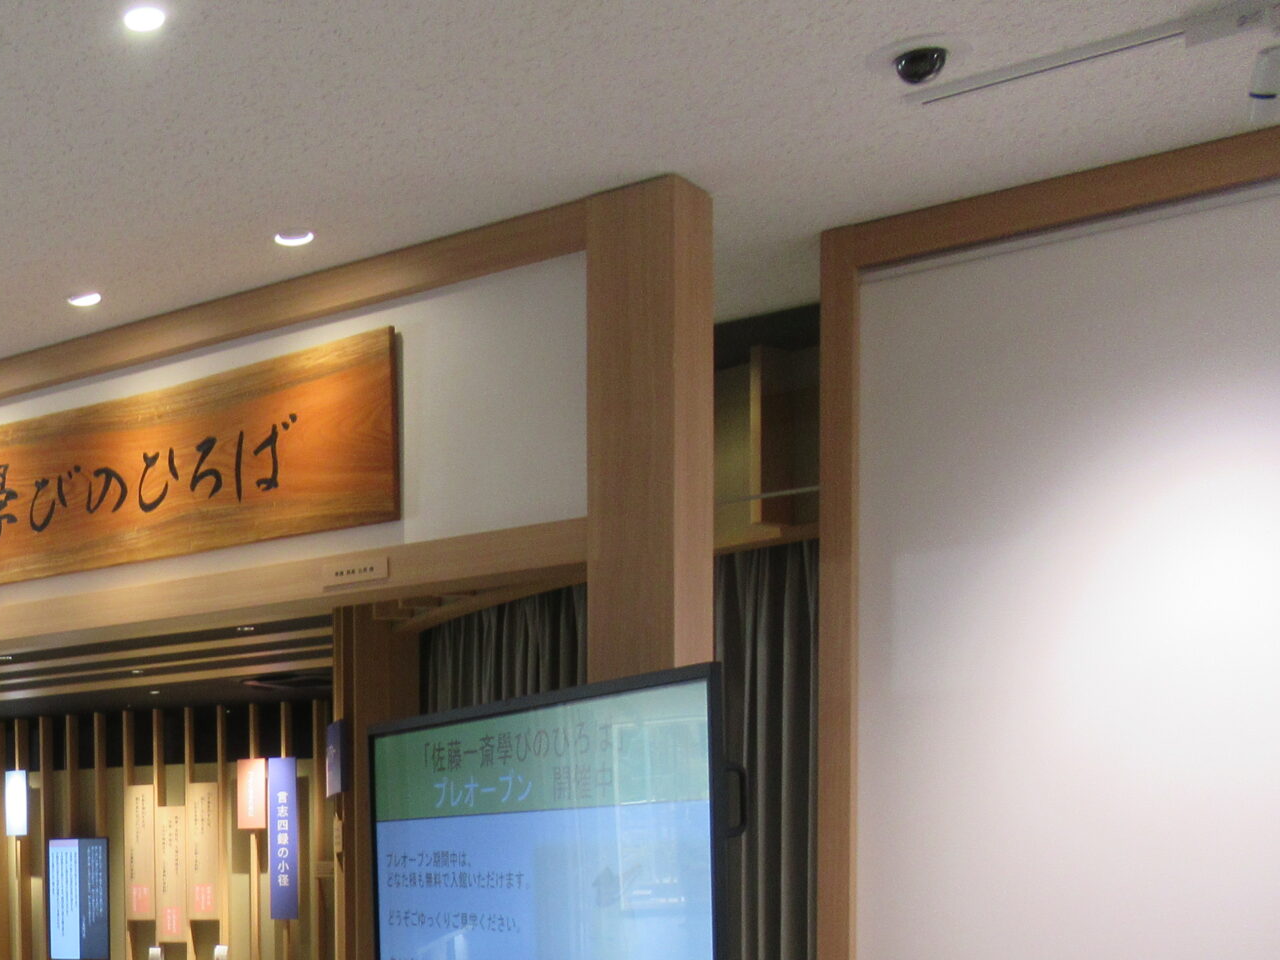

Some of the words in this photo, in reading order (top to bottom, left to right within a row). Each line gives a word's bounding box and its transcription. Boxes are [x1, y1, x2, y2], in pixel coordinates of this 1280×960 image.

[433, 768, 533, 808] プレオープン
[552, 765, 613, 802] 開催中
[276, 790, 290, 887] 言志四録の小径
